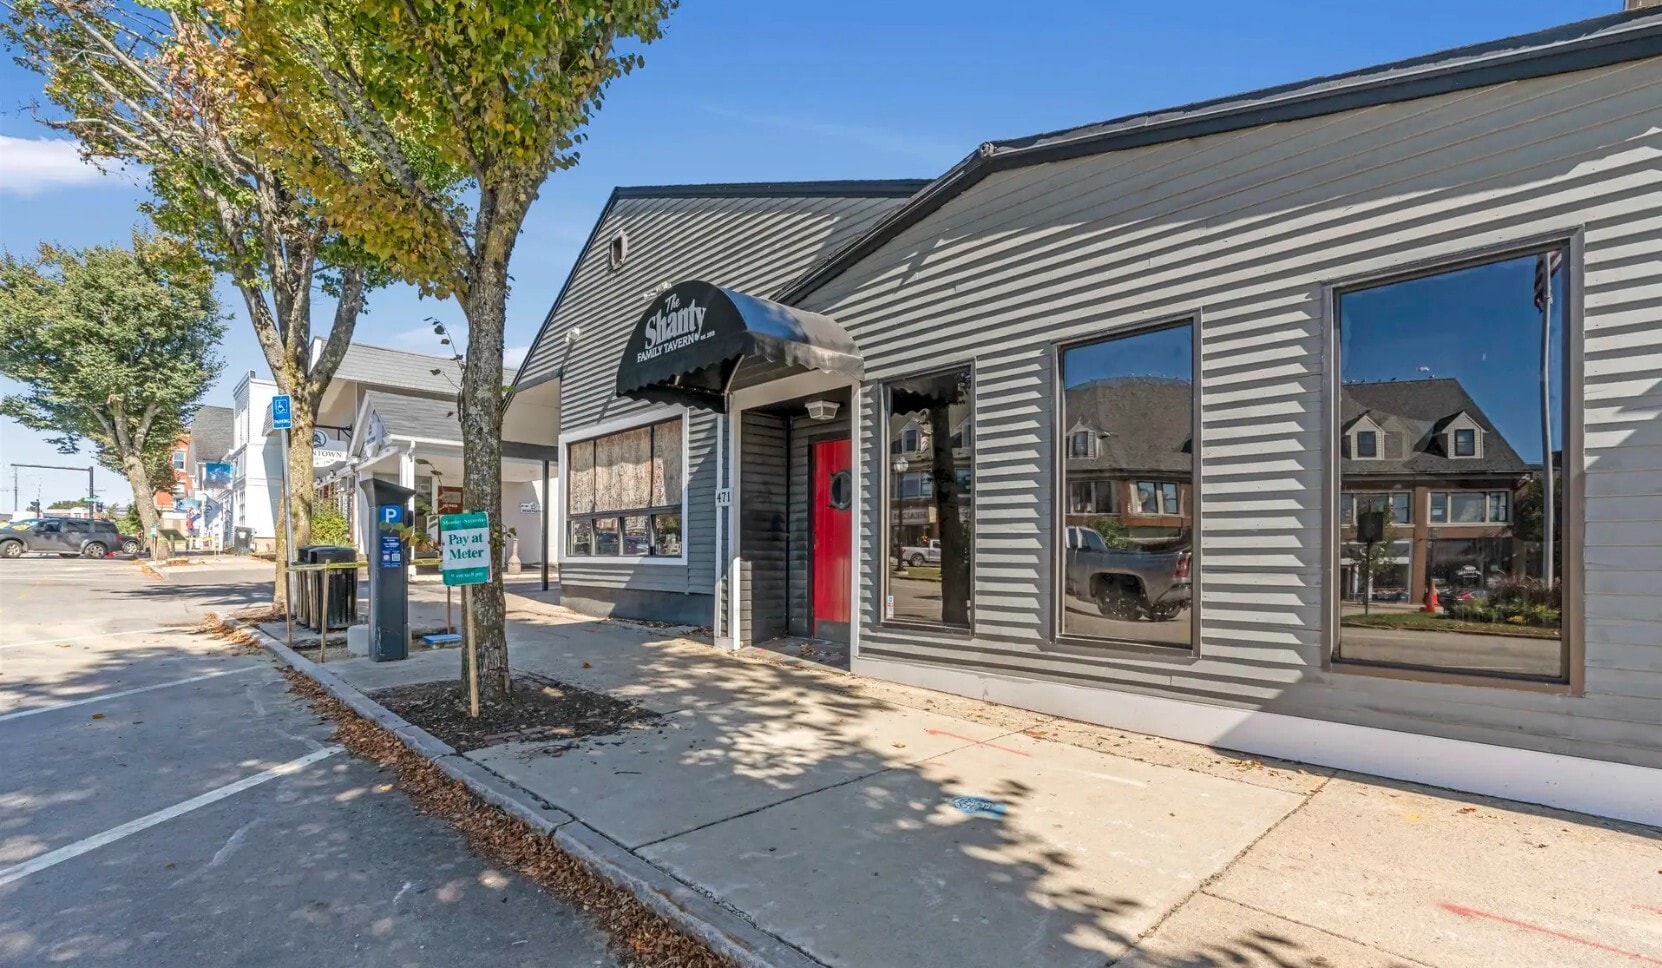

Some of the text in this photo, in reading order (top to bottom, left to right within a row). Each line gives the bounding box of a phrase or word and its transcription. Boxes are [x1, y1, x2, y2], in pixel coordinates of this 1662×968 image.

[665, 293, 680, 313] The
[645, 298, 707, 349] Shanty
[637, 344, 664, 363] FAMILY
[663, 332, 694, 354] TAVERN
[716, 488, 730, 503] 471
[385, 508, 397, 523] P
[448, 533, 483, 546] Pay at
[449, 548, 484, 560] Meter
